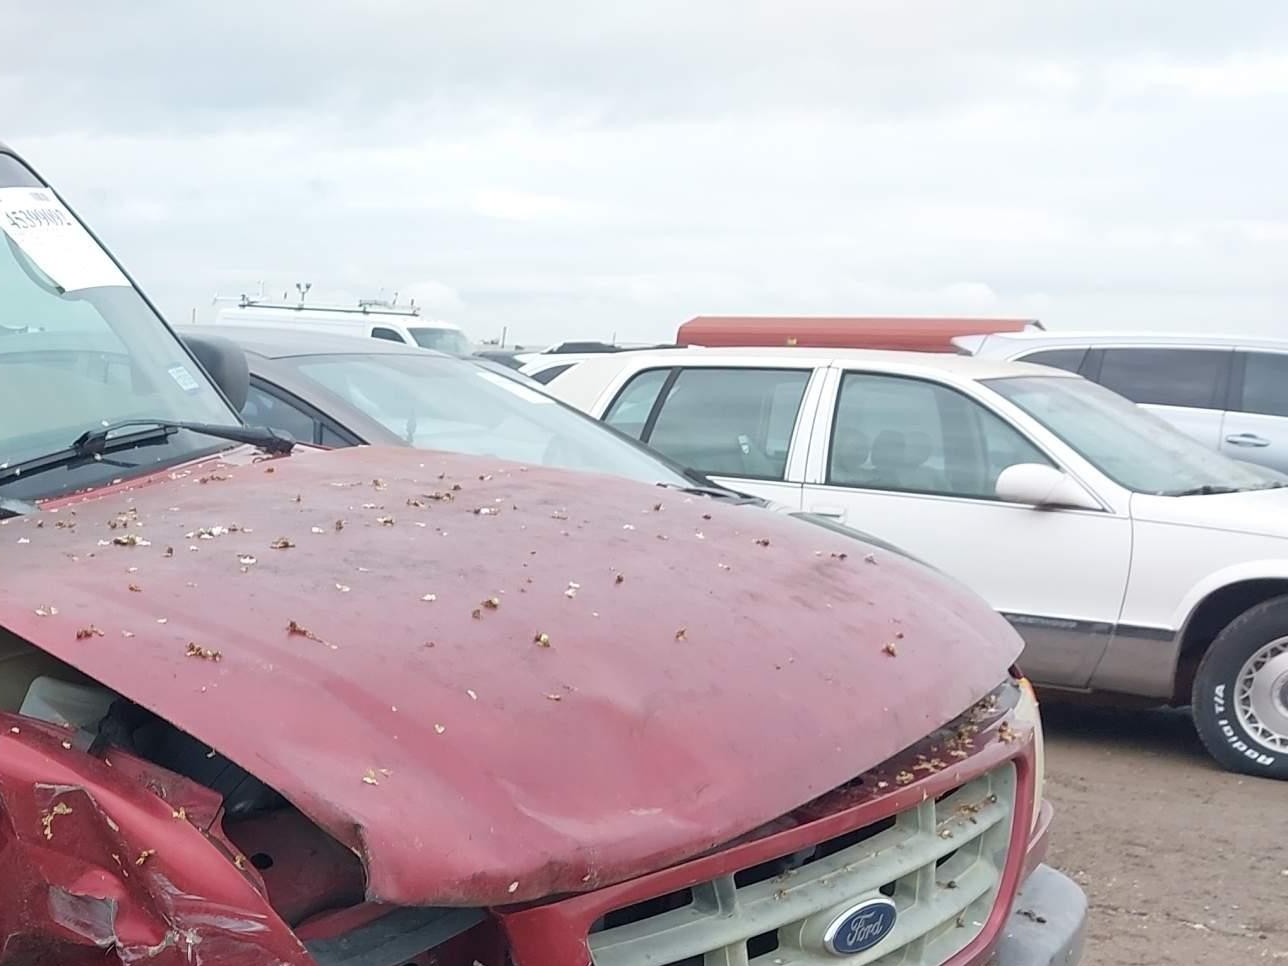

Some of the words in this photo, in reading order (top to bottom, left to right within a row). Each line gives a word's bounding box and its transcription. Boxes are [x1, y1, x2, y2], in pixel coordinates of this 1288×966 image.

[1214, 684, 1225, 713] T/A
[1218, 720, 1274, 765] Radial
[847, 911, 884, 946] Ford
